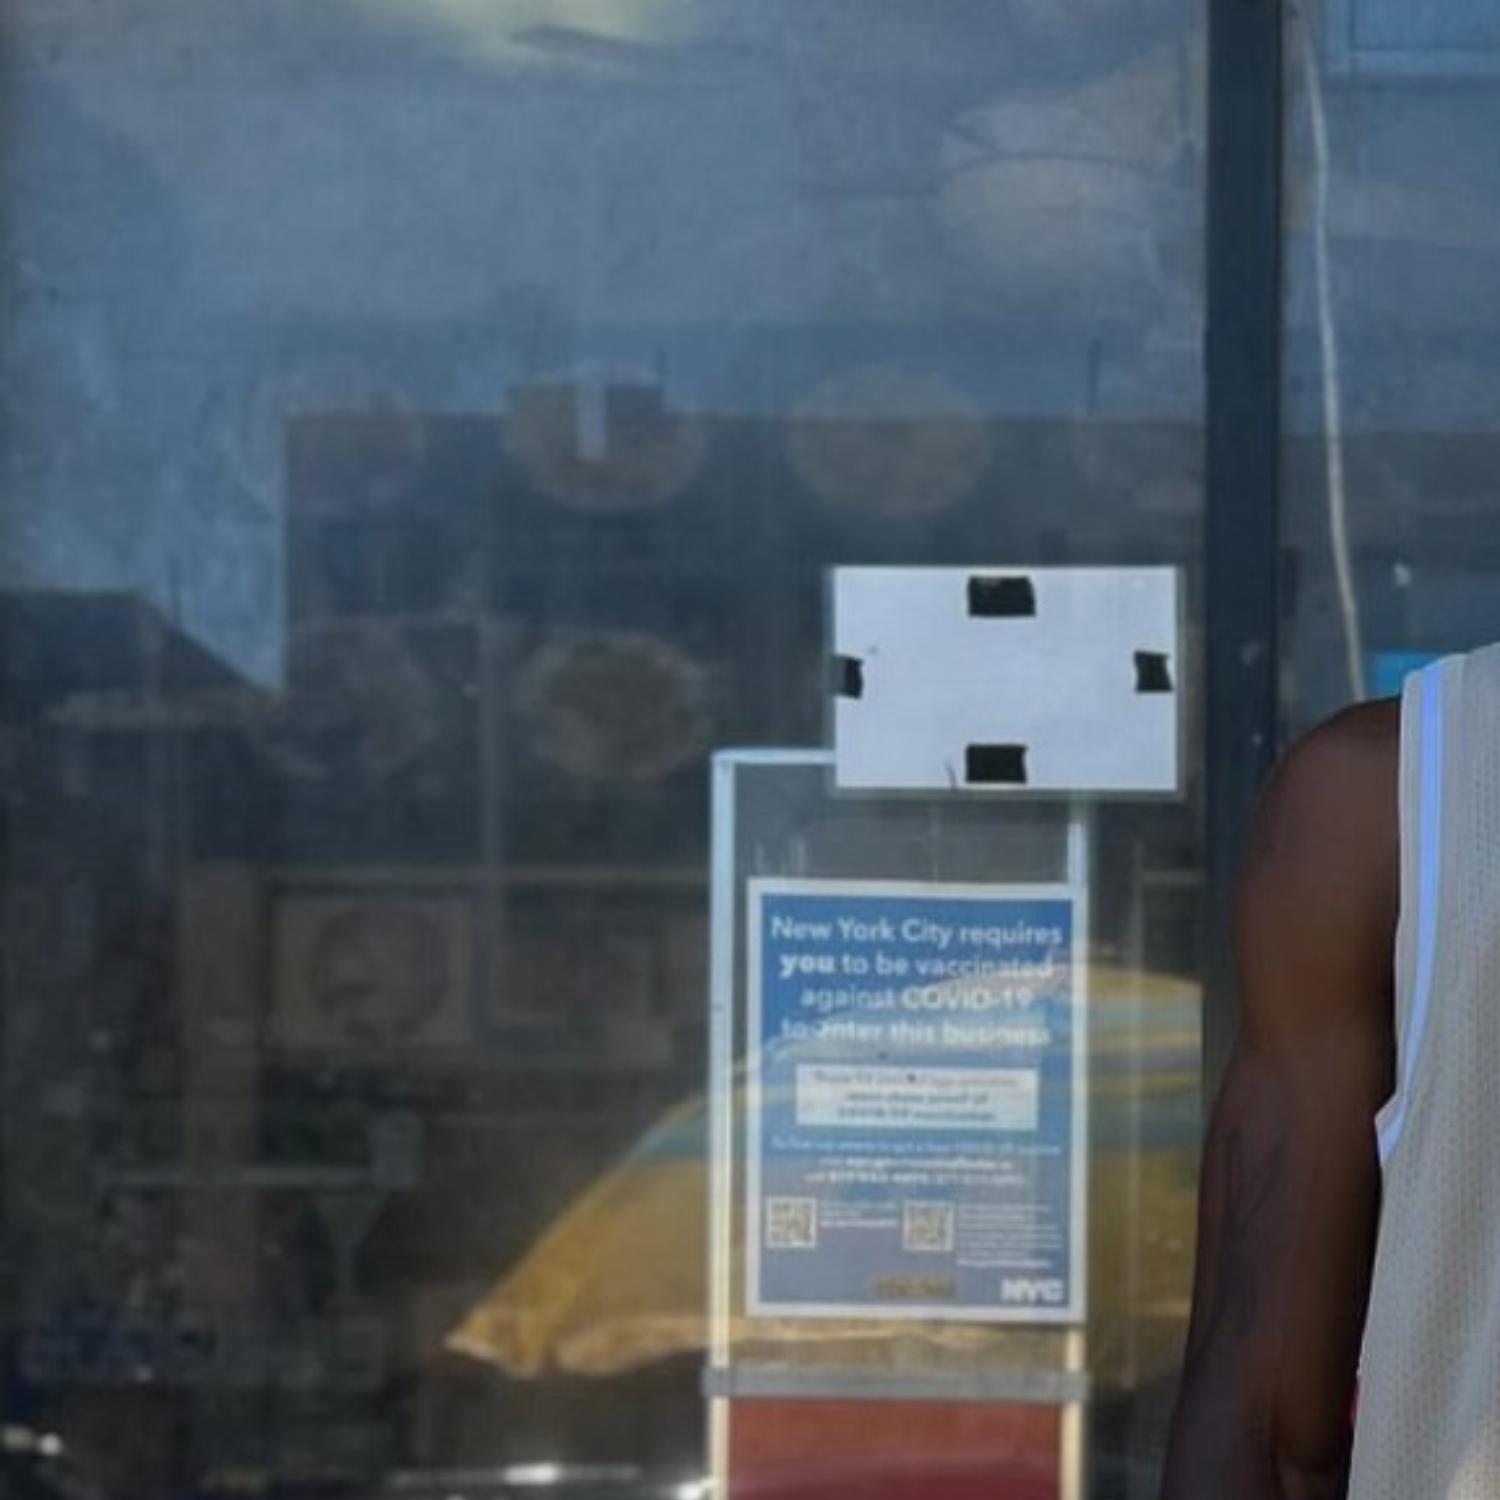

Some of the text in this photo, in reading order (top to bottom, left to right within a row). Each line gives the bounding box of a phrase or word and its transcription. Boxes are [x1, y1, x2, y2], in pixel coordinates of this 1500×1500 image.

[771, 915, 1063, 950] New York City requires
[779, 951, 1054, 979] you to be vaccinated
[800, 985, 1034, 1012] against COVID-19
[781, 1018, 808, 1041] to
[813, 1020, 883, 1043] enter
[889, 1020, 935, 1044] this
